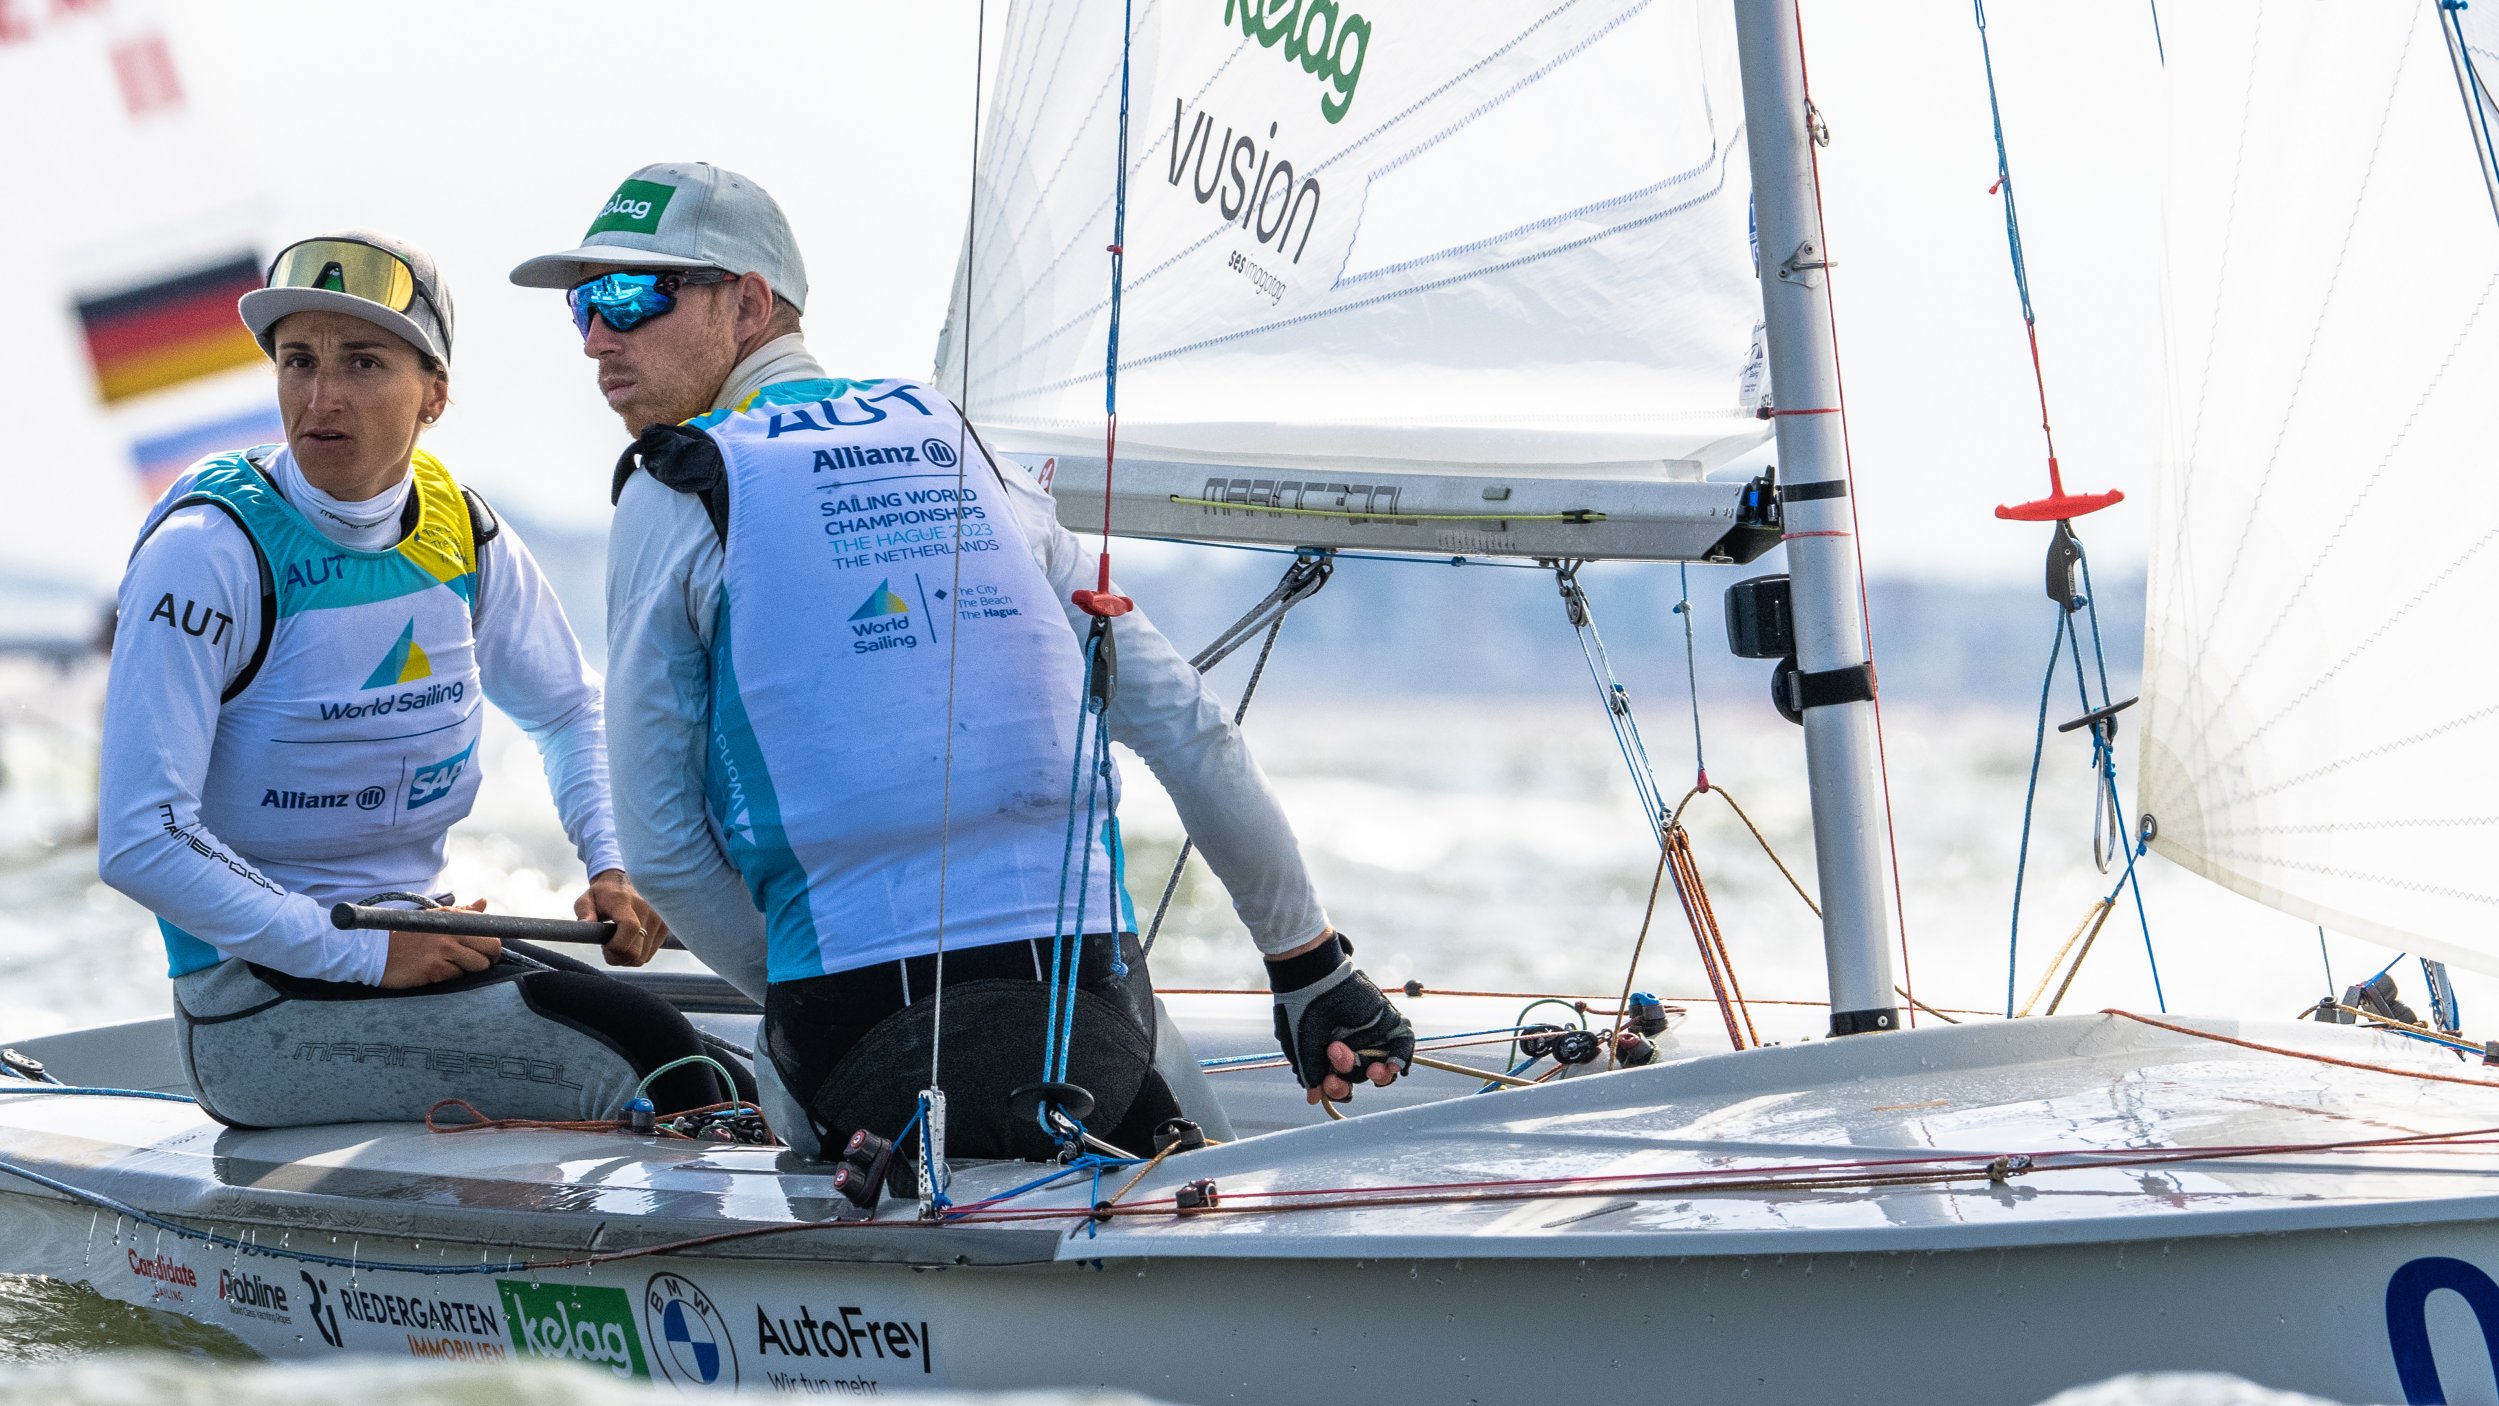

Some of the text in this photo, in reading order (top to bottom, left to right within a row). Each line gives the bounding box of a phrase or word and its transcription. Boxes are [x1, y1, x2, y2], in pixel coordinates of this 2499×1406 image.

[1169, 97, 1320, 264] vusion
[600, 194, 652, 219] elag
[1228, 250, 1286, 306] ses imagotag
[767, 384, 932, 438] AUT
[813, 446, 920, 473] Allianz
[821, 488, 977, 516] SAILING WORLD
[825, 506, 985, 536] CHAMPIONSHIPS
[828, 523, 993, 554] THE HAGUE 2023
[284, 554, 346, 593] AUT
[832, 540, 1000, 570] THE NETHERLANDS
[958, 595, 1013, 609] The Beach
[976, 584, 998, 596] City
[148, 592, 233, 645] AUT
[852, 616, 910, 637] World
[959, 608, 1022, 620] The Hague.
[853, 634, 917, 654] Sailing
[320, 681, 464, 721] World Sailing
[409, 758, 467, 801] SAP
[716, 733, 746, 812] World
[261, 789, 348, 810] Allianz
[293, 1042, 583, 1092] MARINEPOOL
[128, 1248, 198, 1288] Candidate
[219, 1268, 289, 1312] Robline
[650, 1279, 710, 1316] BMW
[340, 1289, 500, 1336] RIEDERGARTEN
[407, 1334, 507, 1363] IMMOBILIEN
[513, 1293, 633, 1379] kelag
[757, 1303, 931, 1373] AutoFrey
[766, 1371, 798, 1395] Wir
[800, 1372, 833, 1395] tun
